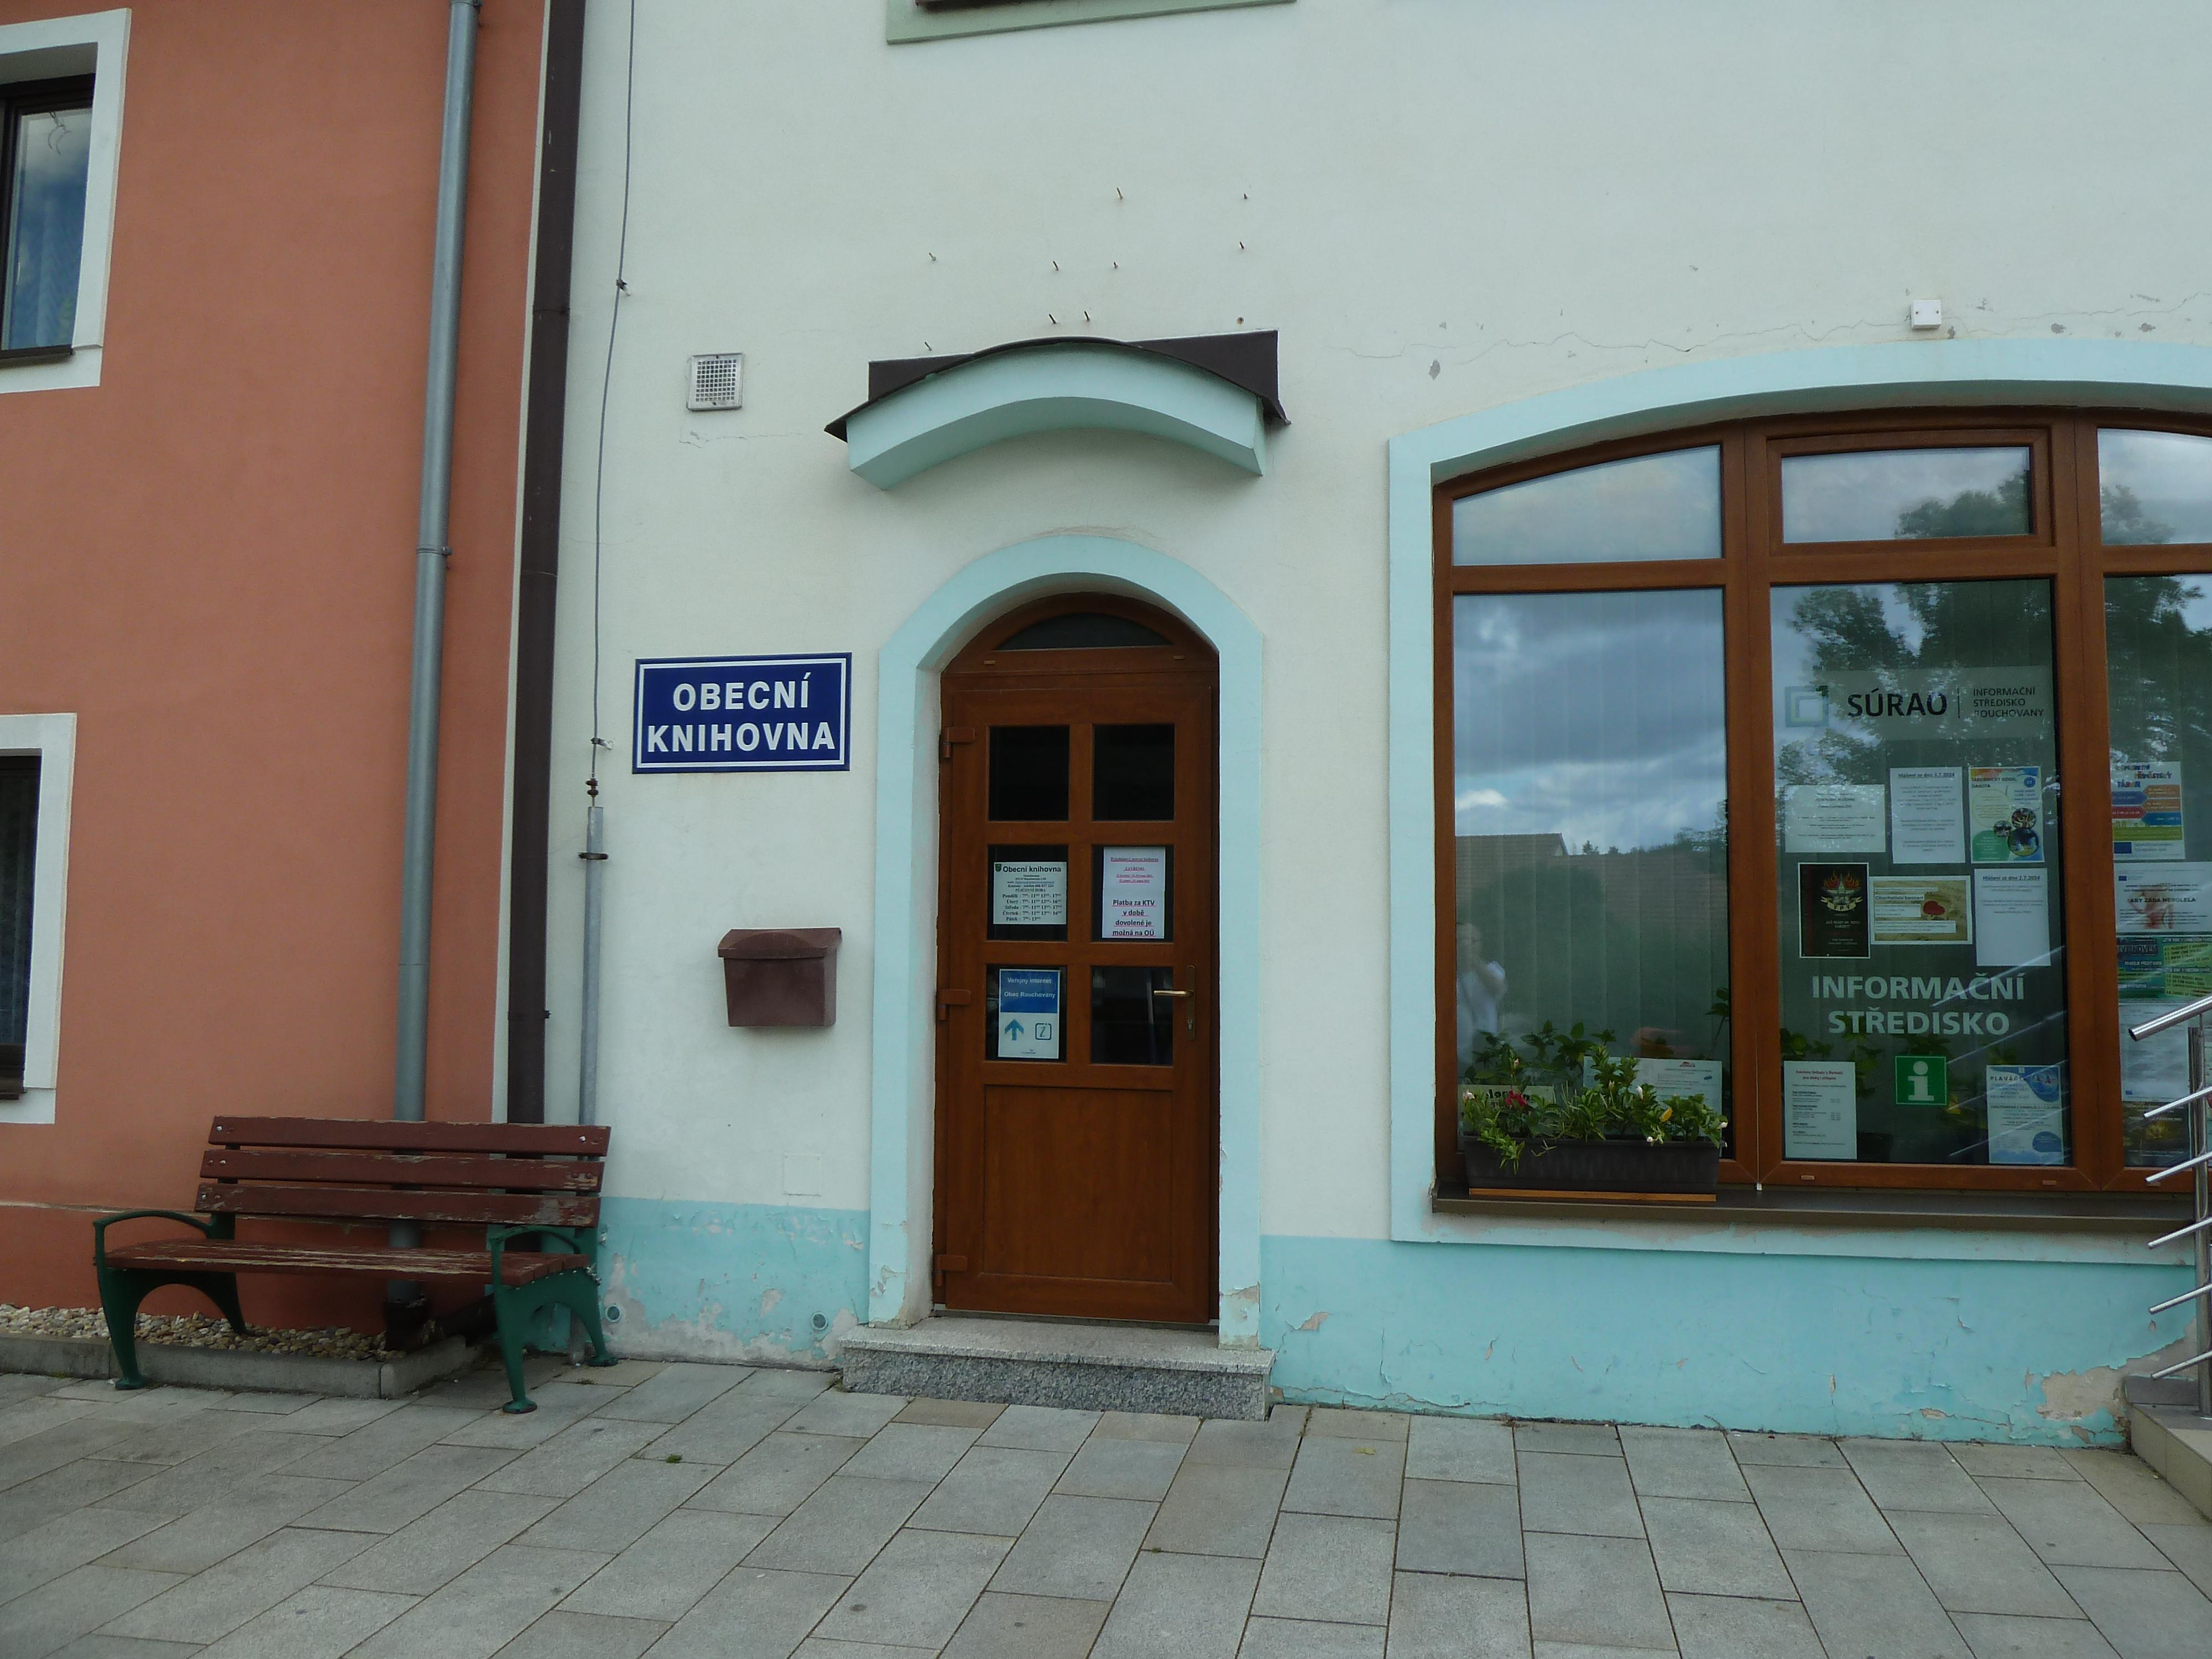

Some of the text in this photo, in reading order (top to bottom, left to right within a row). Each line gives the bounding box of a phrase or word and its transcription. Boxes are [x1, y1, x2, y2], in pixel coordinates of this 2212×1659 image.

[673, 672, 811, 711] OBECNÍ
[1847, 687, 1948, 718] SÚRAO
[1973, 698, 2026, 707] STŘEDISKO
[647, 722, 836, 753] KNIHOVNA
[1812, 972, 2026, 1000] INFORMAČNÍ
[1828, 1006, 2010, 1035] STŘEDISKO
